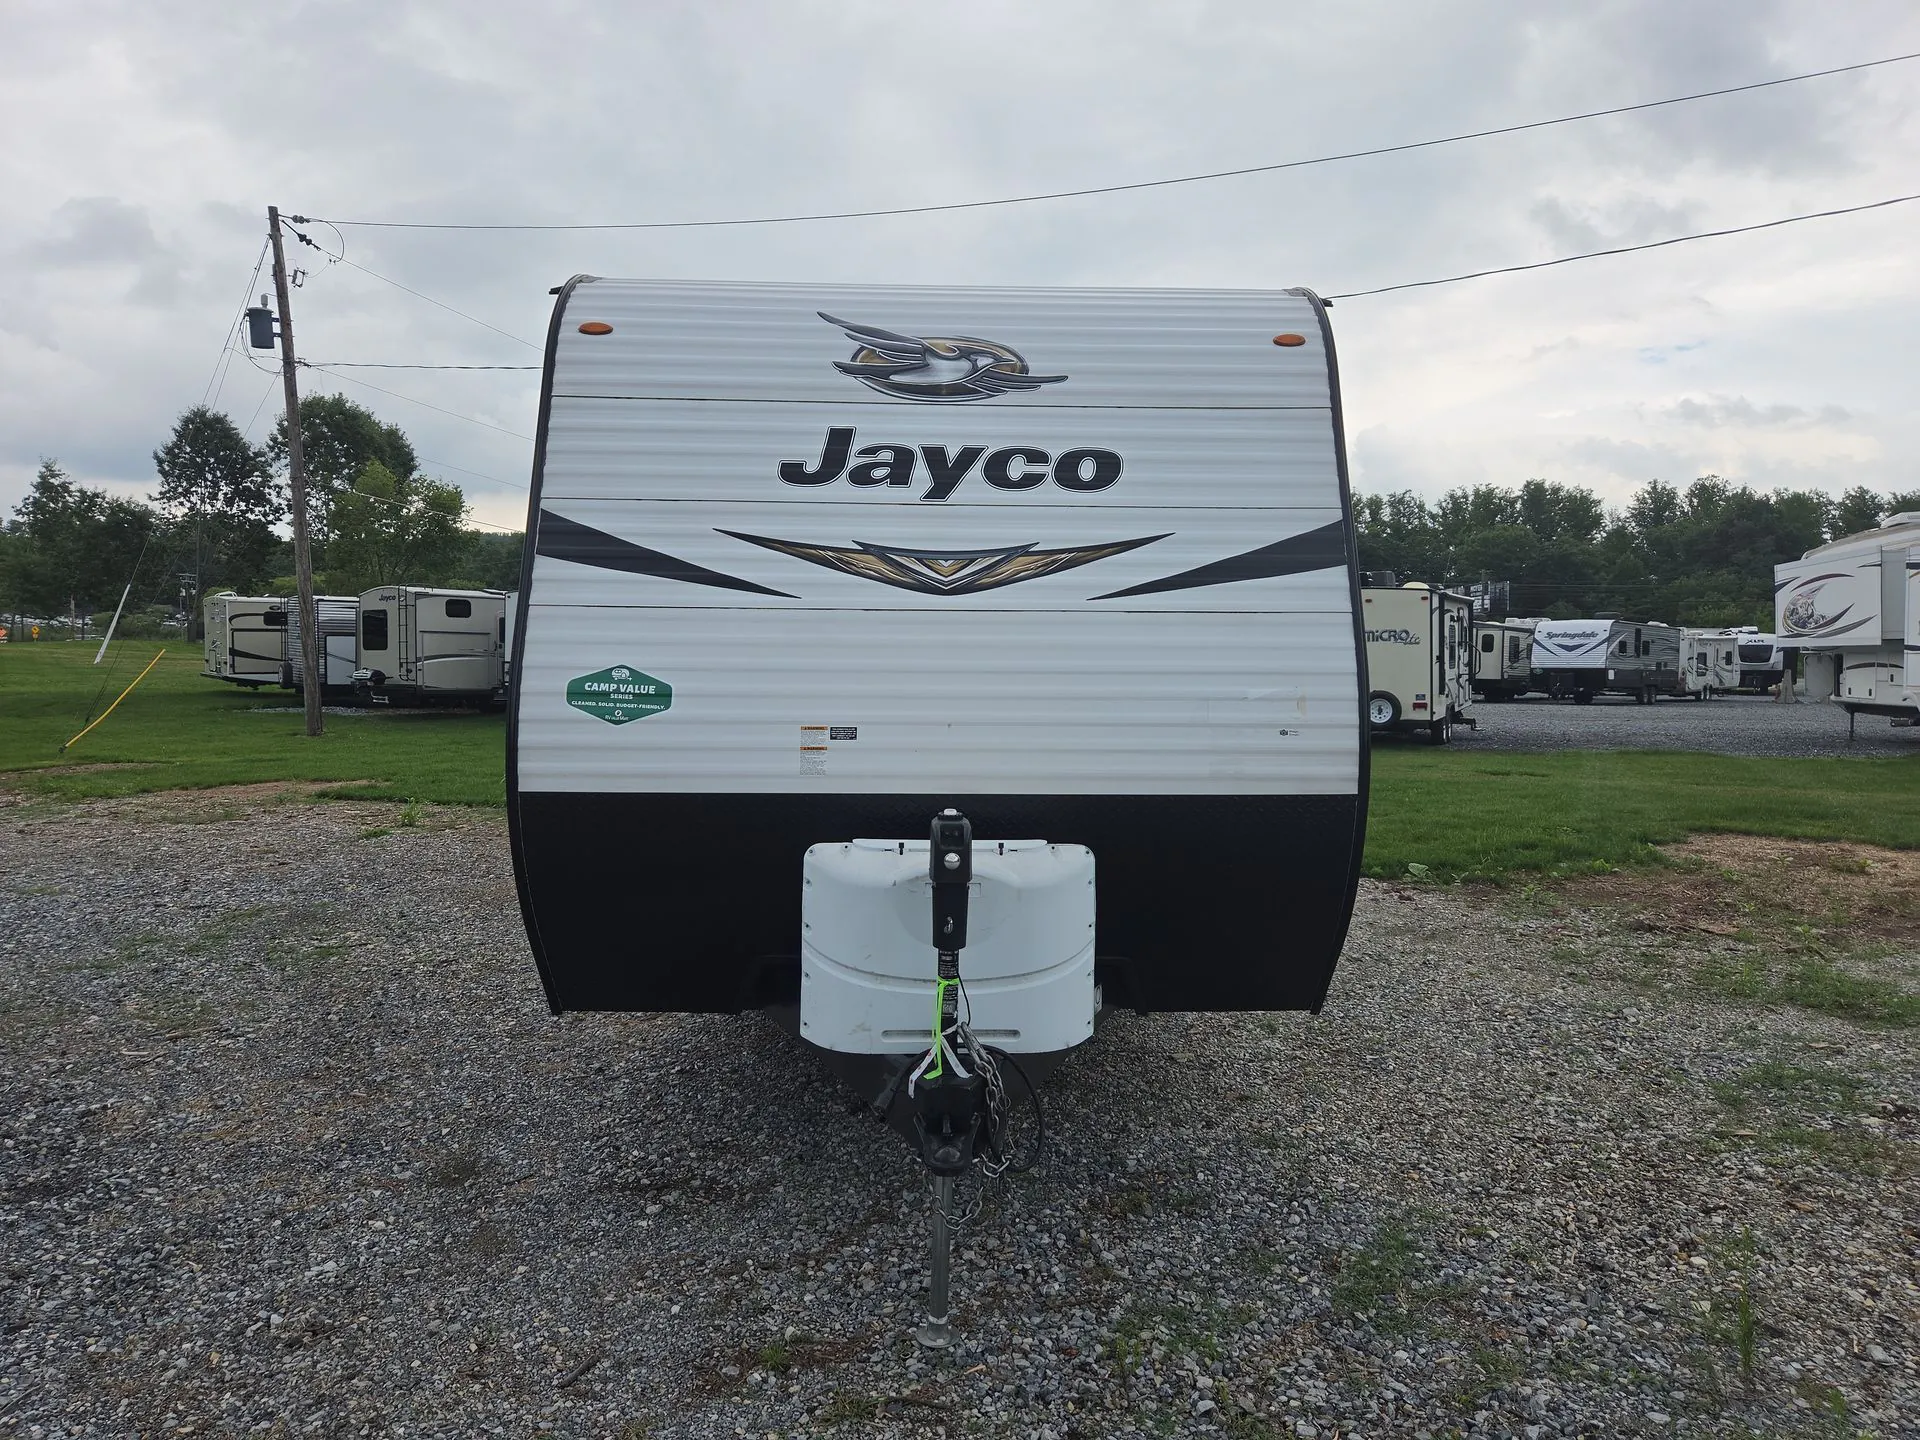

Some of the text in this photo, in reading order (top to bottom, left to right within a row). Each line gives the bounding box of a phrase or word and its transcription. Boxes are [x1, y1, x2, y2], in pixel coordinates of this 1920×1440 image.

[777, 425, 1124, 502] Jayco
[378, 593, 397, 603] Jayco
[1544, 631, 1600, 640] Springdale
[584, 682, 656, 695] CAMP VALUE
